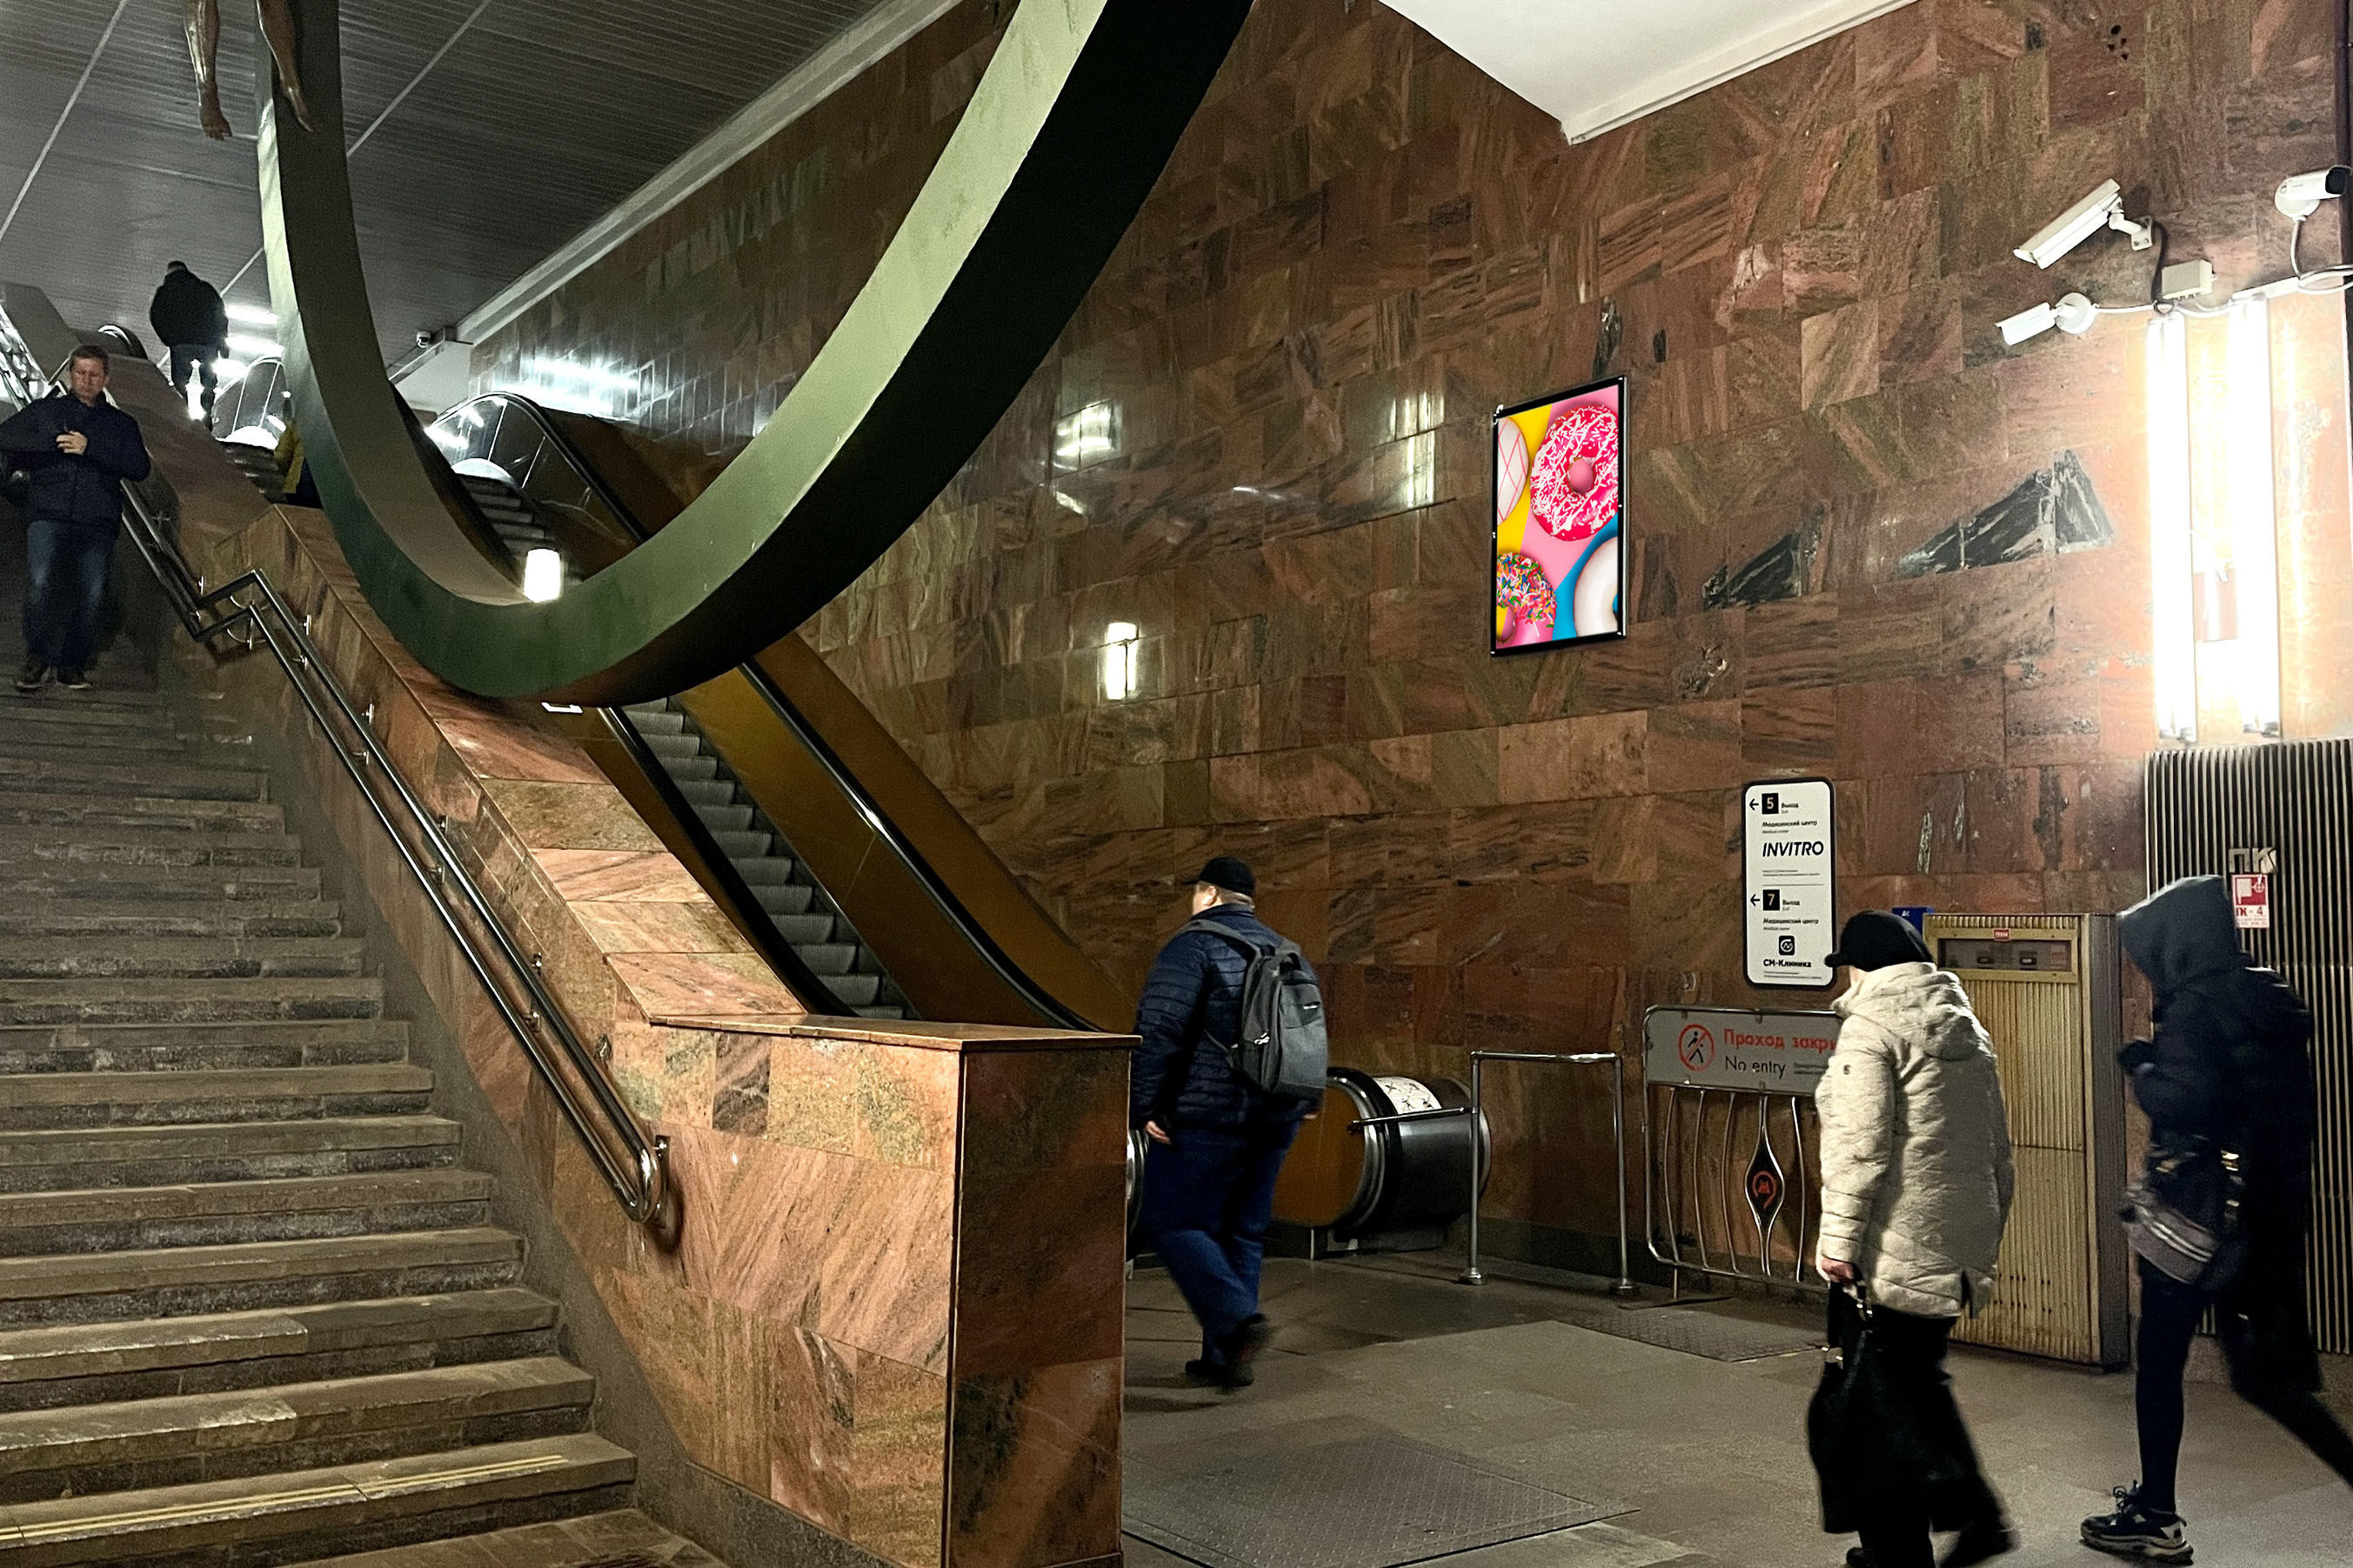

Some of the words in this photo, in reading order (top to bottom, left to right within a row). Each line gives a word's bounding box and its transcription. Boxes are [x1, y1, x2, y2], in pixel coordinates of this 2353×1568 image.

[1767, 797, 1775, 810] 5
[1762, 840, 1824, 857] INVITRO
[1768, 893, 1775, 906] 7
[1763, 958, 1812, 968] СМ-Клиника
[1723, 1029, 1786, 1050] Проход
[1725, 1056, 1747, 1071] No
[1752, 1060, 1786, 1079] entry
